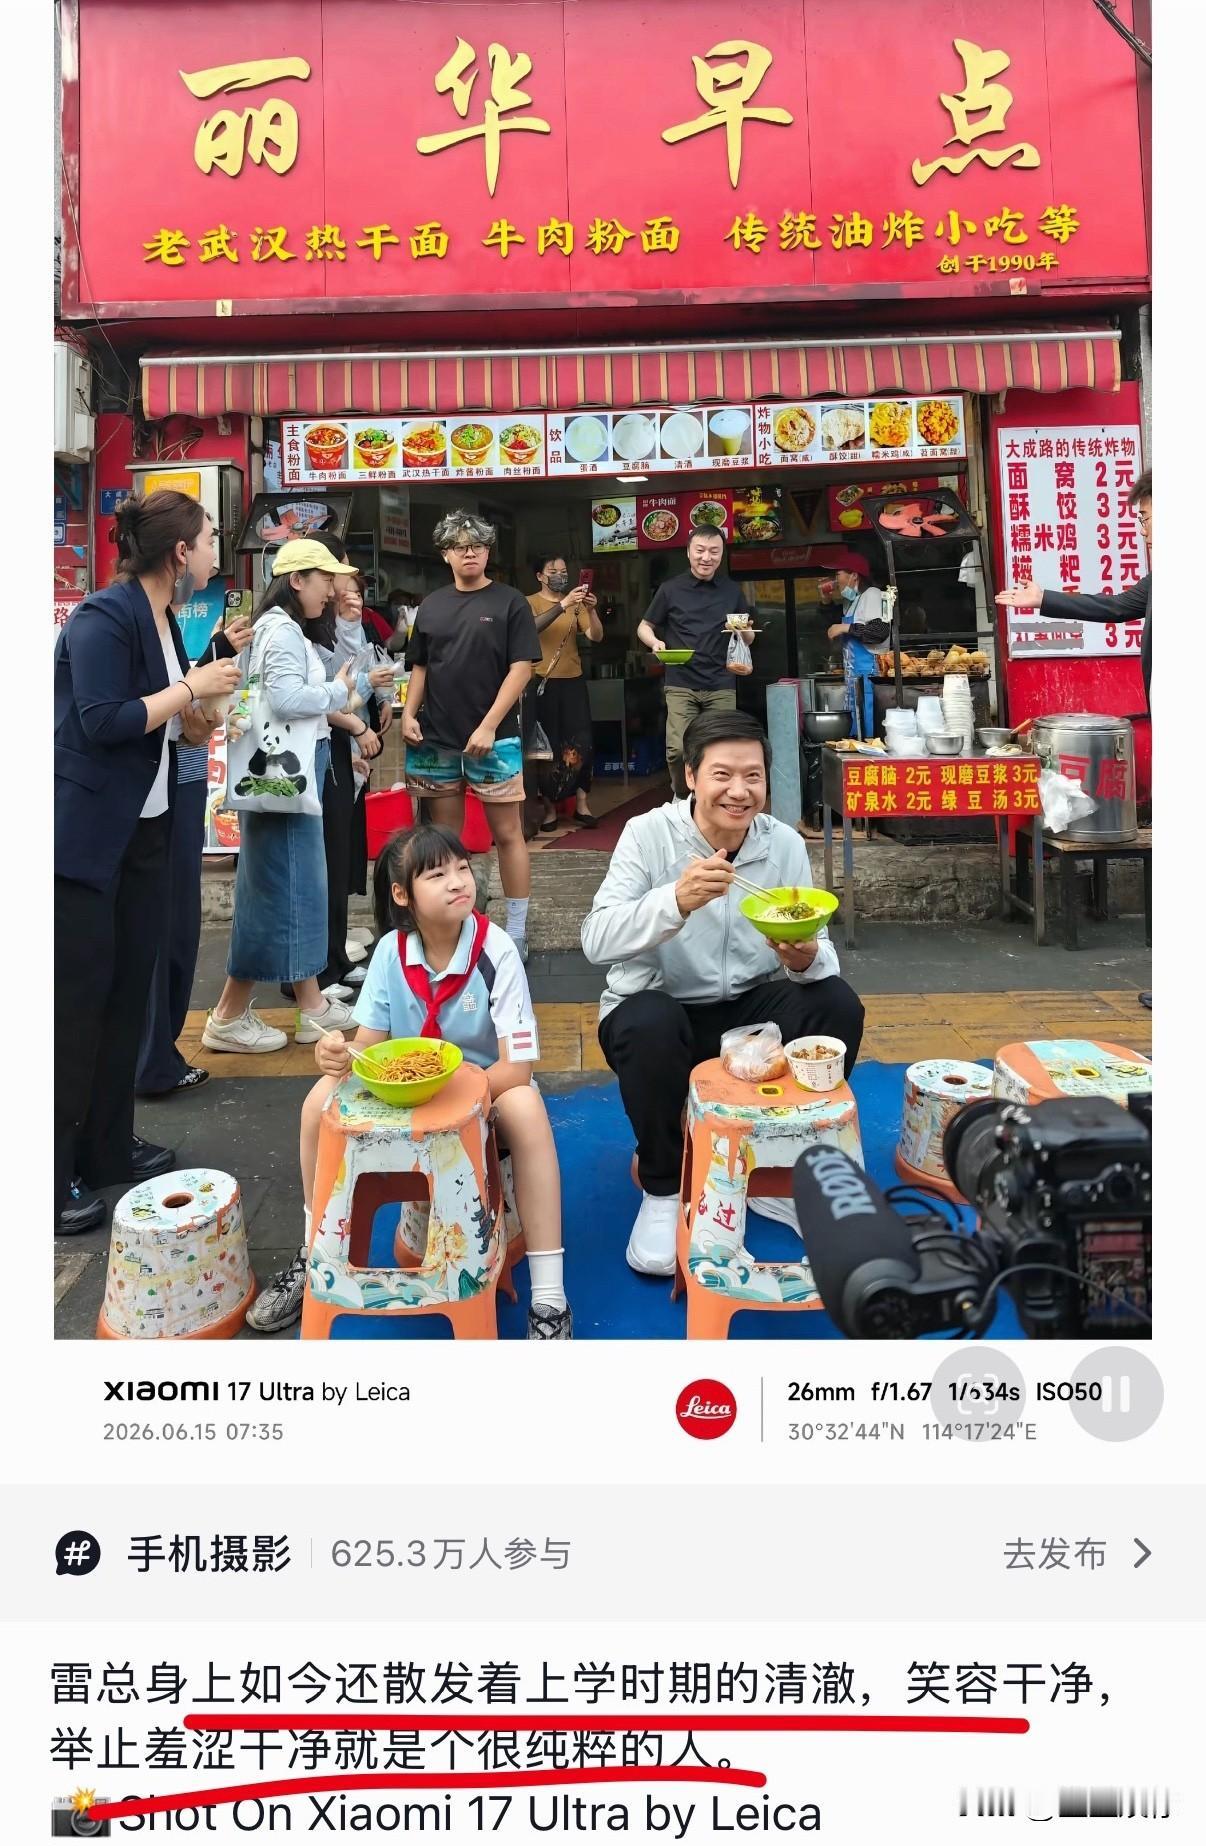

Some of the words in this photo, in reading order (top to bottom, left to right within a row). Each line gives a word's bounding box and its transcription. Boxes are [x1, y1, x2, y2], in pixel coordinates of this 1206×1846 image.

[178, 36, 1042, 198] 丽华早点
[143, 221, 450, 267] 老武汉热干面
[481, 215, 680, 258] 牛肉粉面
[724, 203, 1082, 255] 传统油炸小吃等
[936, 251, 1060, 275] 创于1990年
[549, 429, 562, 464] 饮品
[757, 406, 772, 466] 炸物小吃
[1005, 437, 1136, 459] 大成路的传统炸物
[287, 425, 300, 481] 主食粉面
[711, 456, 749, 467] 现磨豆浆
[308, 471, 347, 481] 牛肉粉面
[358, 470, 396, 480] 三鲜粉面
[402, 468, 450, 478] 武汉热干面
[455, 467, 494, 476] 炸酱粉面
[503, 466, 541, 476] 肉丝粉面
[1007, 461, 1075, 490] 面窝
[1008, 492, 1078, 521] 酥饺
[1010, 523, 1078, 552] 糯米鸡
[1097, 522, 1138, 551] 3元
[1100, 553, 1140, 582] 2元
[847, 765, 897, 786] 豆腐脑
[905, 766, 931, 785] 2元
[941, 764, 1008, 786] 现磨豆浆
[1012, 764, 1039, 783] 3元
[846, 790, 898, 811] 矿泉水
[906, 791, 931, 811] 2元
[941, 789, 1008, 811] 绿豆汤
[1013, 789, 1039, 809] 3元
